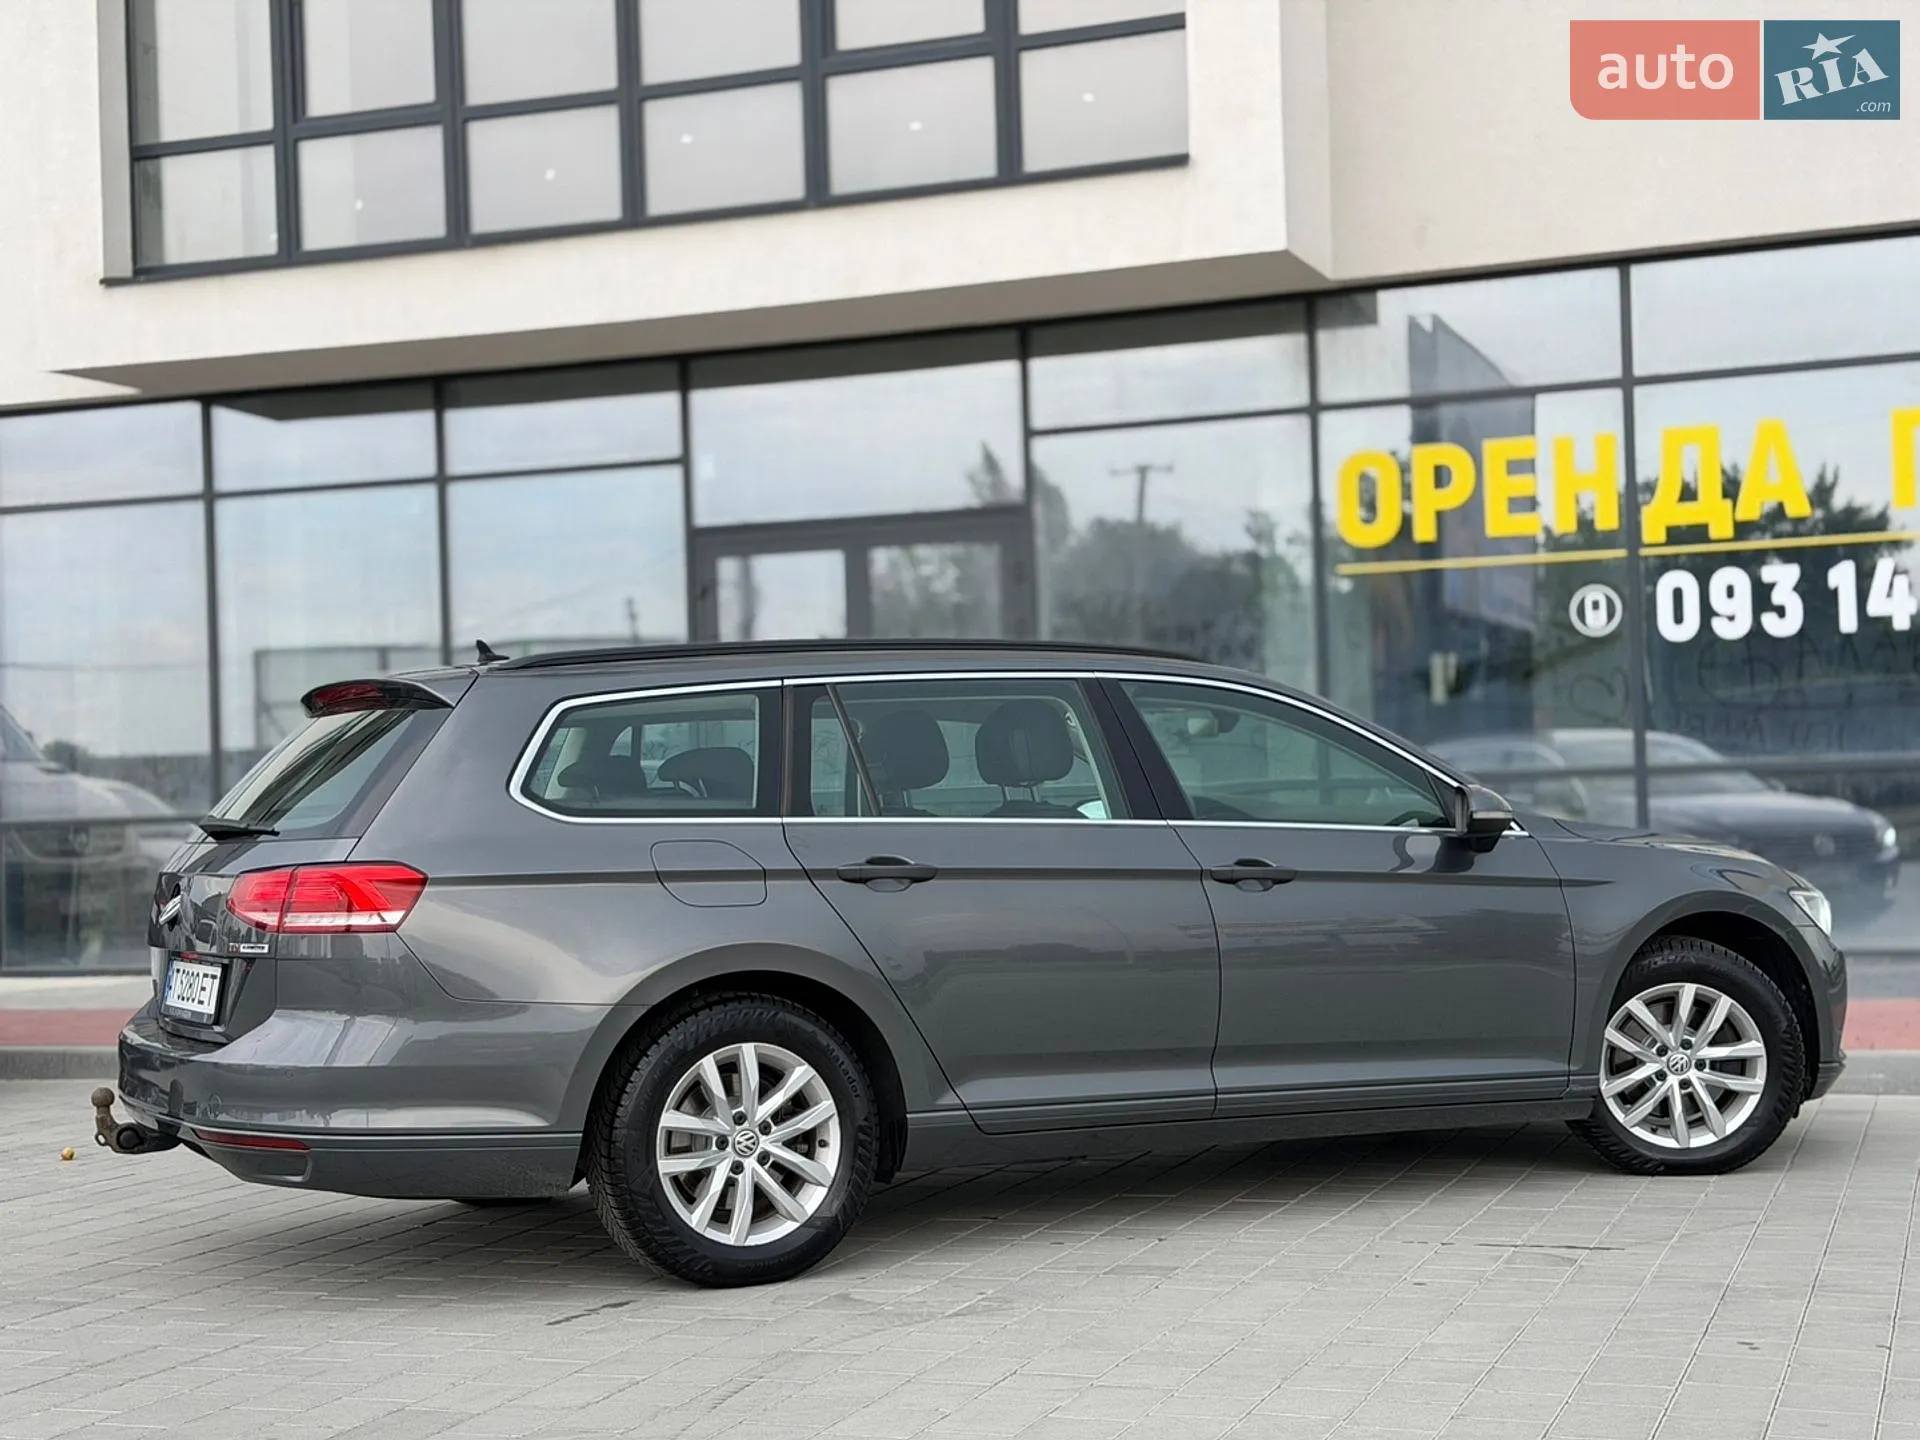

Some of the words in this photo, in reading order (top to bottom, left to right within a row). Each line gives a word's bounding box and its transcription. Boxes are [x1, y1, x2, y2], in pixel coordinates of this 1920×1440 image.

[1336, 418, 1813, 549] ОРЕНДА
[1656, 562, 1804, 643] 093
[1827, 557, 1918, 635] 14
